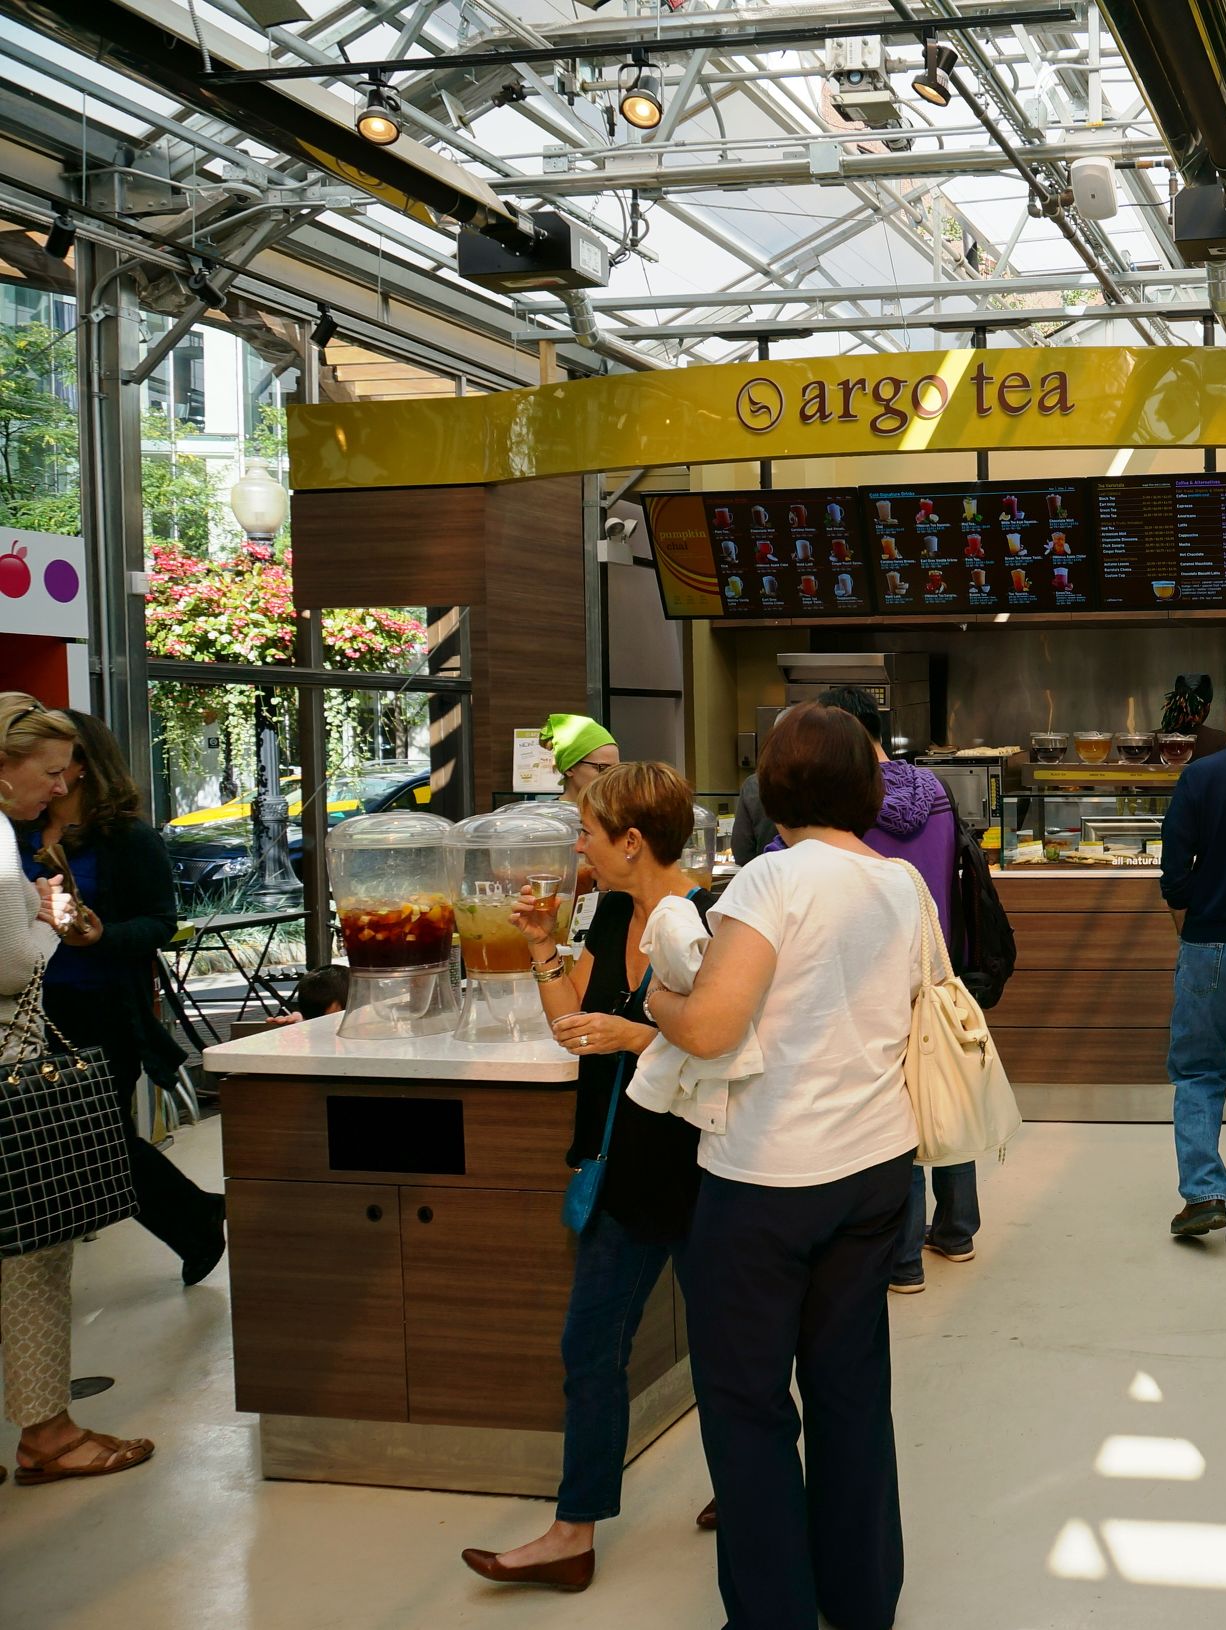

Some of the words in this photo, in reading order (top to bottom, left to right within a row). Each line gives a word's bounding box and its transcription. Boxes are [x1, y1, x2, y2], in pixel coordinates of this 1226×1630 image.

[799, 375, 949, 437] argo
[970, 361, 1074, 416] tea
[659, 530, 707, 541] pumpkin
[667, 542, 688, 550] chai
[1112, 856, 1123, 865] all
[1127, 856, 1161, 865] natural
